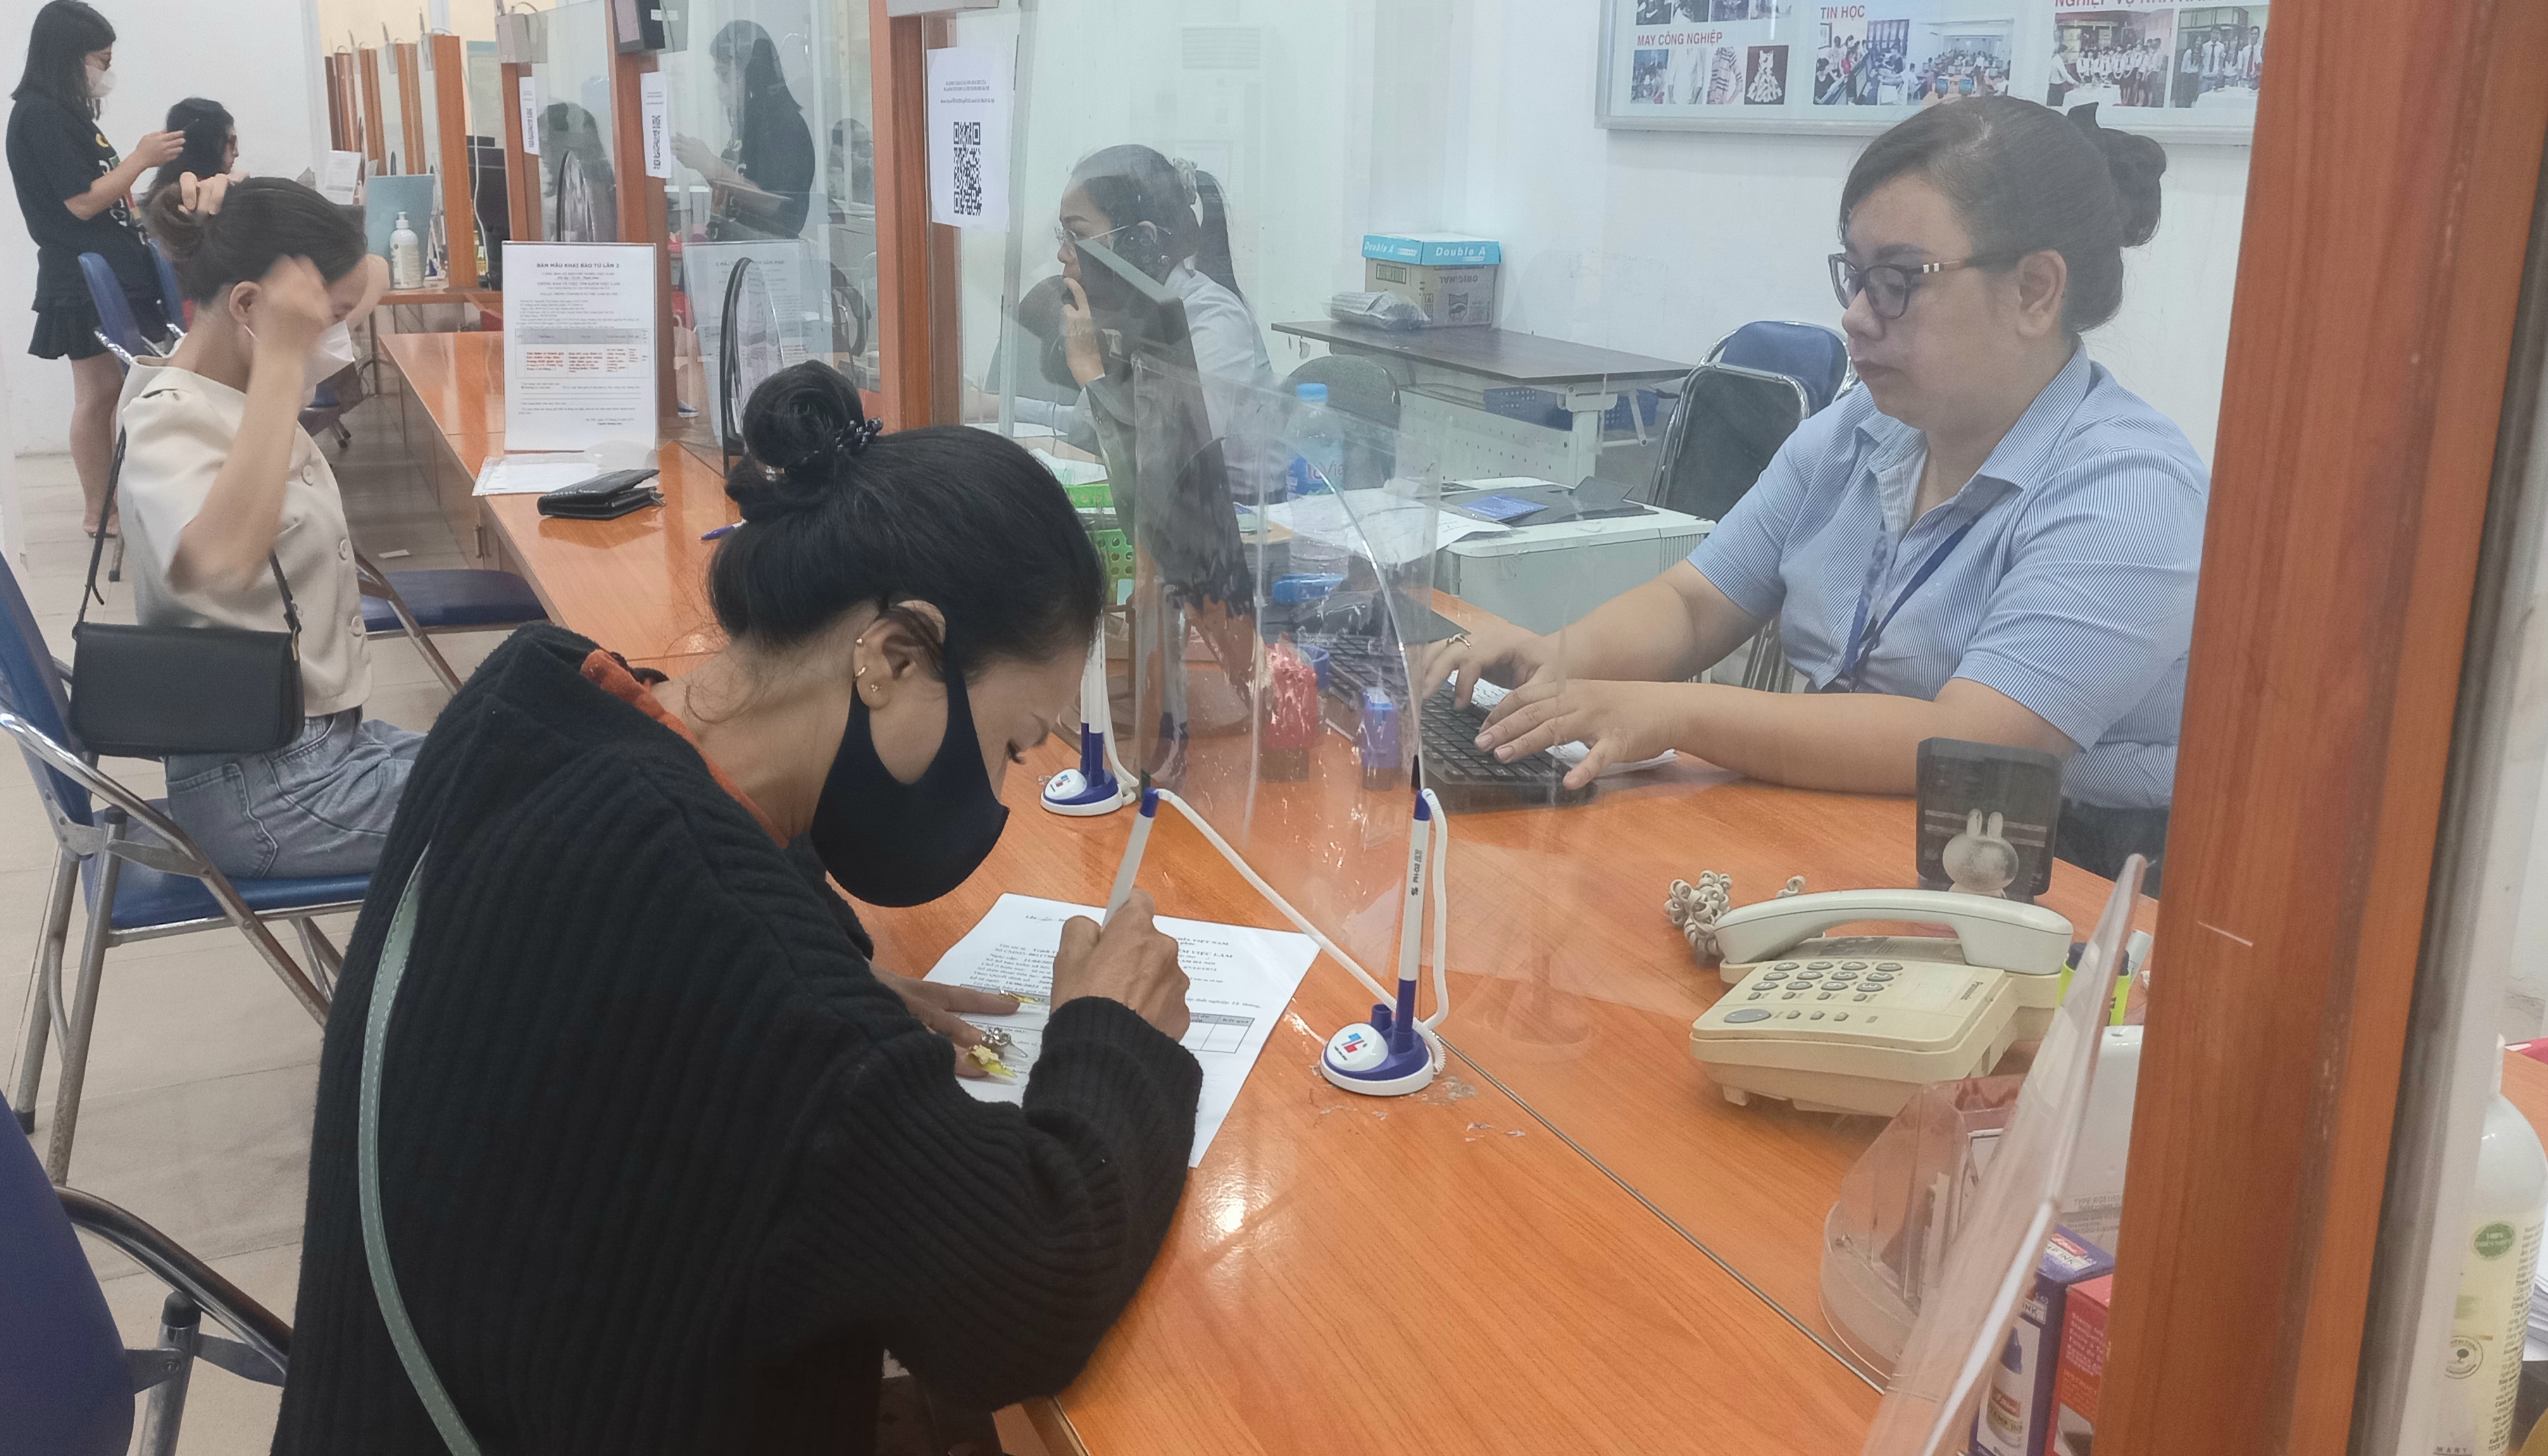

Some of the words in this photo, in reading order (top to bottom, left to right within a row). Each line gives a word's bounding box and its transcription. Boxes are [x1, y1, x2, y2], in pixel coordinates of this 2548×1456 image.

[1820, 6, 1837, 19] TIN
[1841, 5, 1865, 20] HỌC
[1637, 35, 1656, 46] MAY
[1658, 31, 1684, 46] CÔNG
[1687, 29, 1722, 46] NGHIỆP
[1365, 241, 1387, 252] Double
[1436, 247, 1475, 256] Double
[1478, 246, 1485, 256] A
[1439, 275, 1478, 283] ORIGINAL
[2058, 1252, 2074, 1266] INK
[2021, 1302, 2039, 1317] INK
